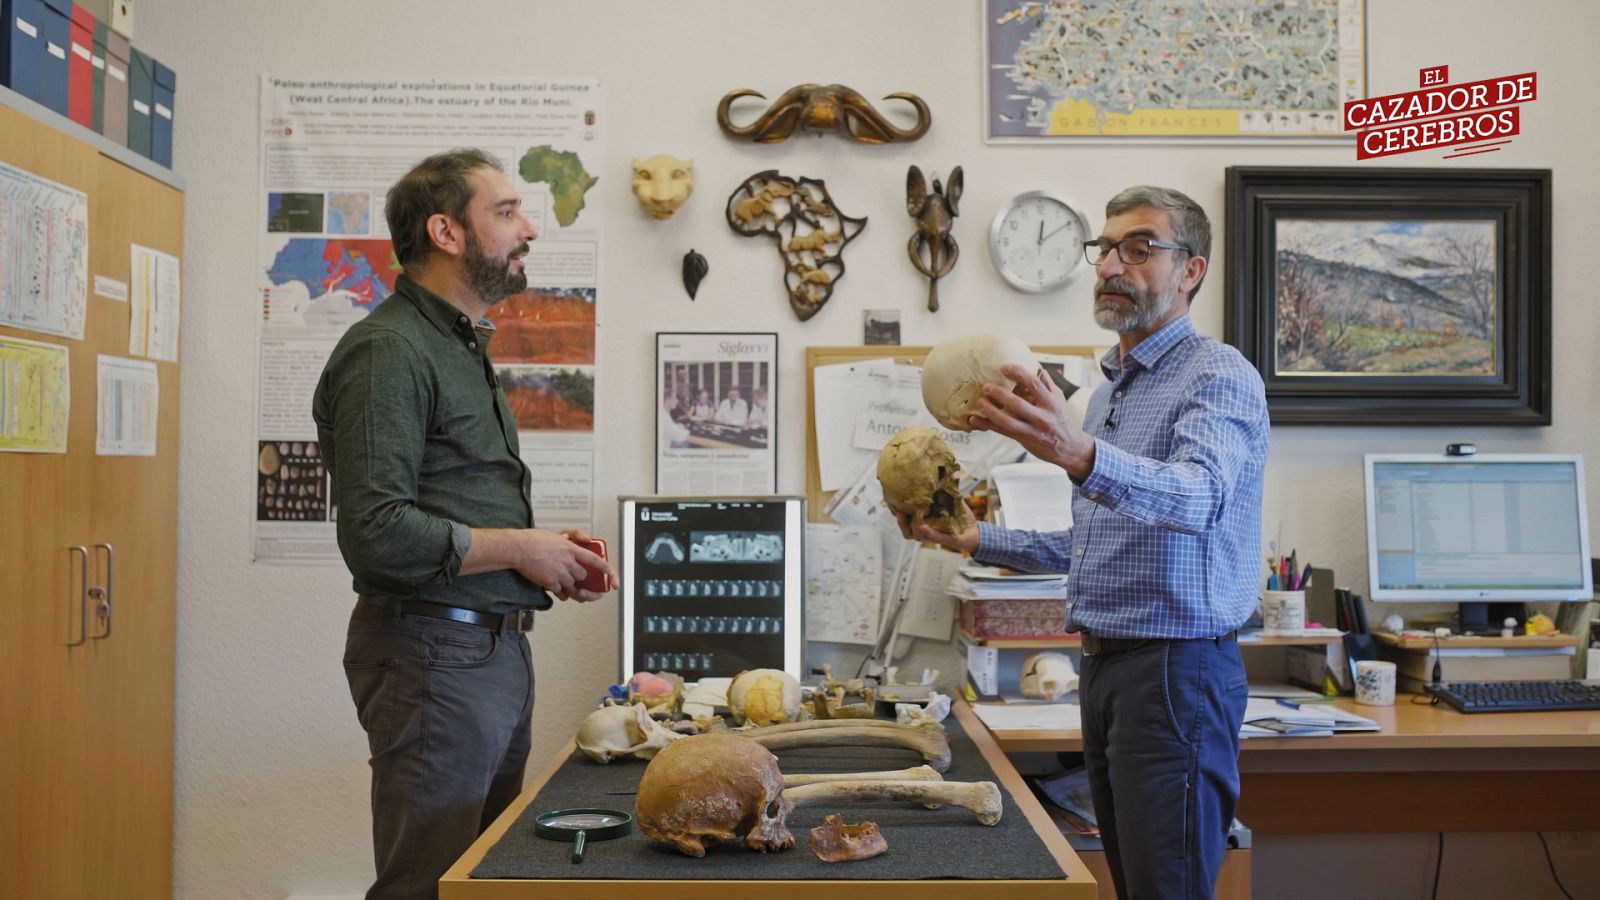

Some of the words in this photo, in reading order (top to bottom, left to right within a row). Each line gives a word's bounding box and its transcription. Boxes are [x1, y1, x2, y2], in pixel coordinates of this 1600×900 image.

[273, 78, 398, 91] Paleo-anthropological
[401, 81, 471, 93] explorations
[475, 82, 485, 91] in
[490, 82, 548, 93] Equatorial
[551, 82, 590, 92] Guinea
[327, 95, 368, 104] Central
[438, 97, 480, 107] estuary
[484, 97, 495, 106] of
[499, 97, 516, 106] the
[867, 400, 919, 416] Professor
[865, 419, 908, 436] Anto
